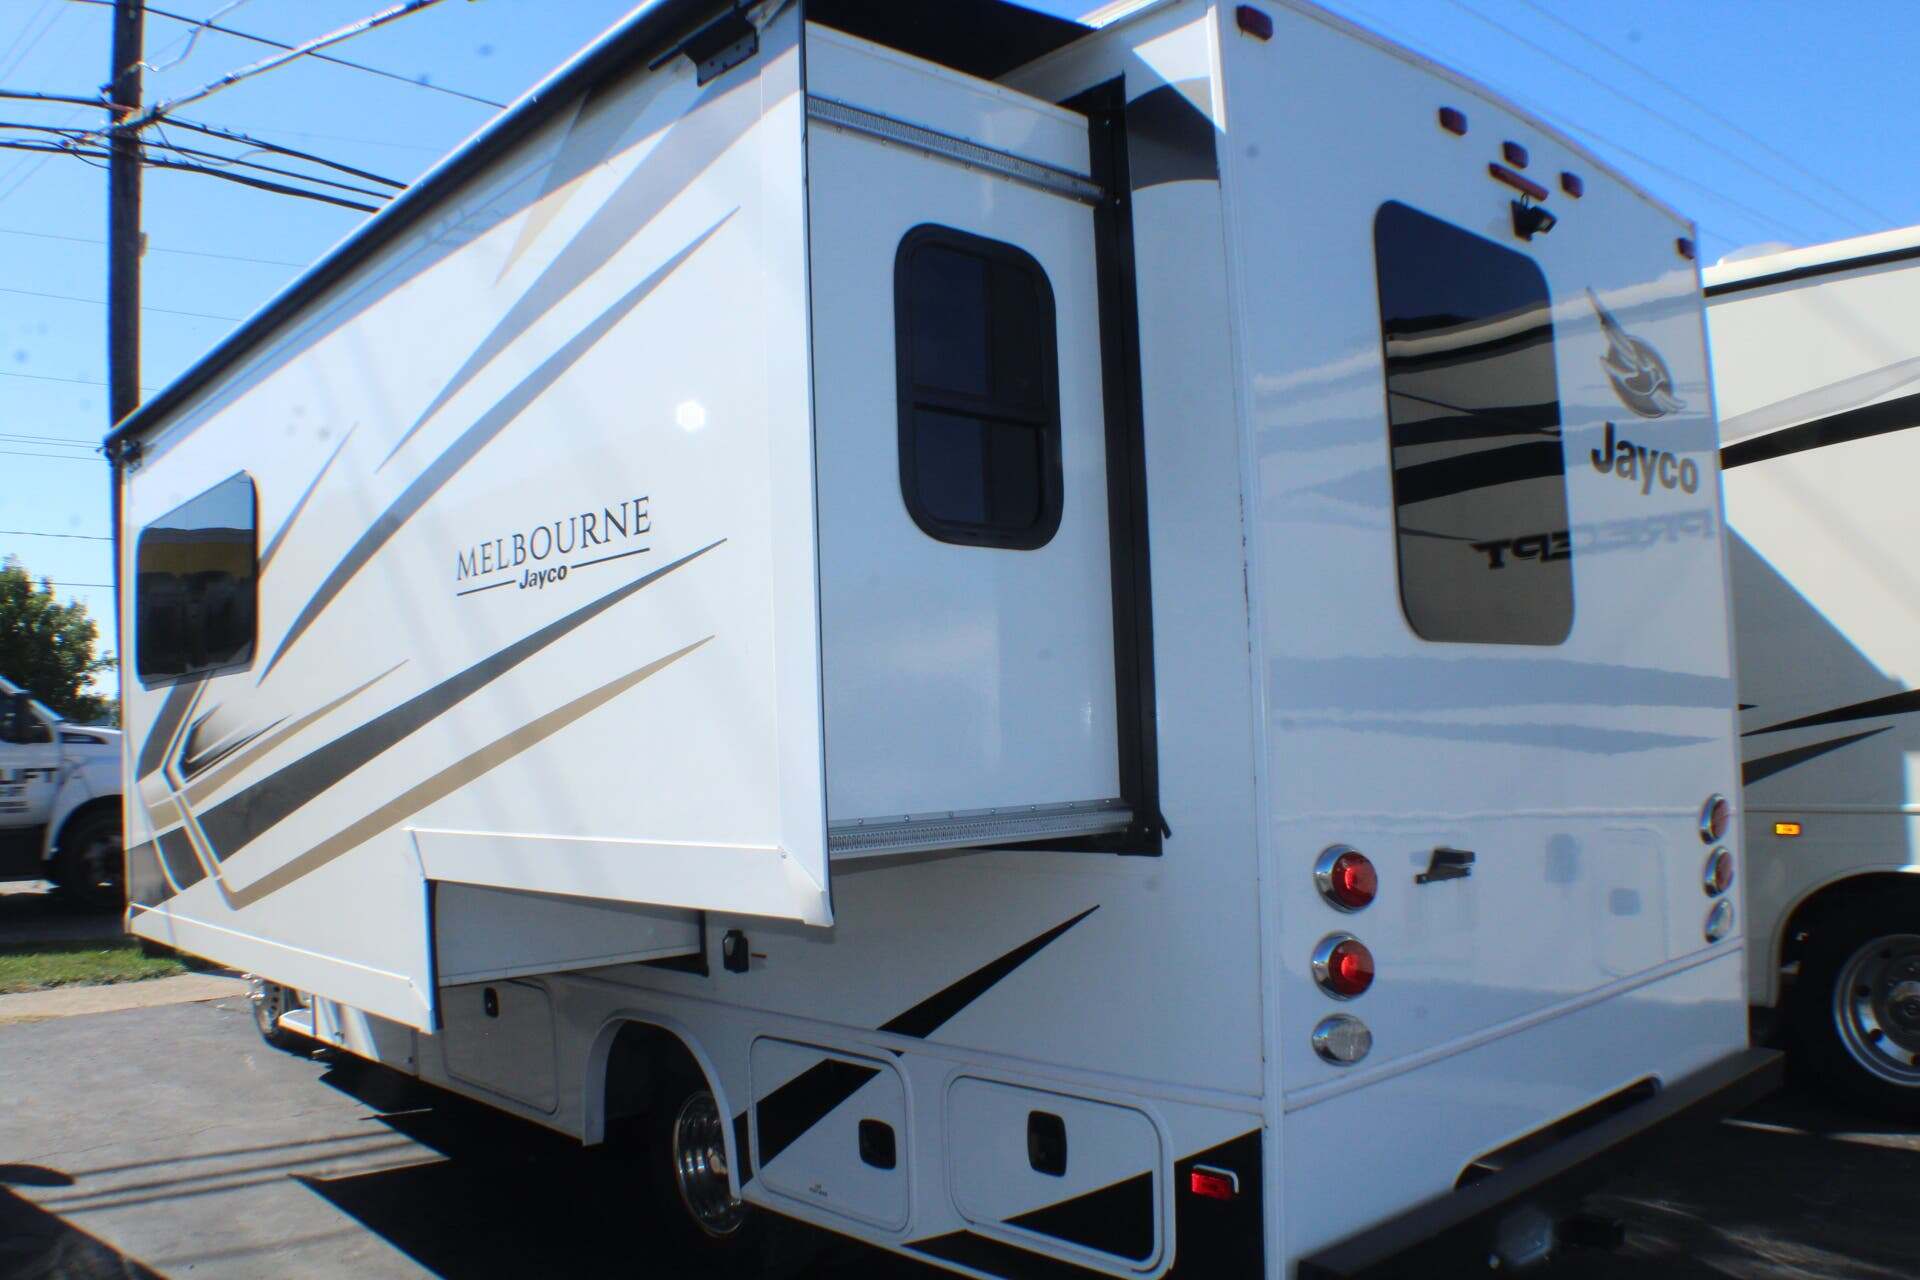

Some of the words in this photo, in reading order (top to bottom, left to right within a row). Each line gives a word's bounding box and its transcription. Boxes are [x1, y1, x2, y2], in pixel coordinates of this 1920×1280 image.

[1591, 421, 1698, 495] Jayco
[456, 496, 651, 580] MELBOURNE
[519, 564, 568, 589] Jayco
